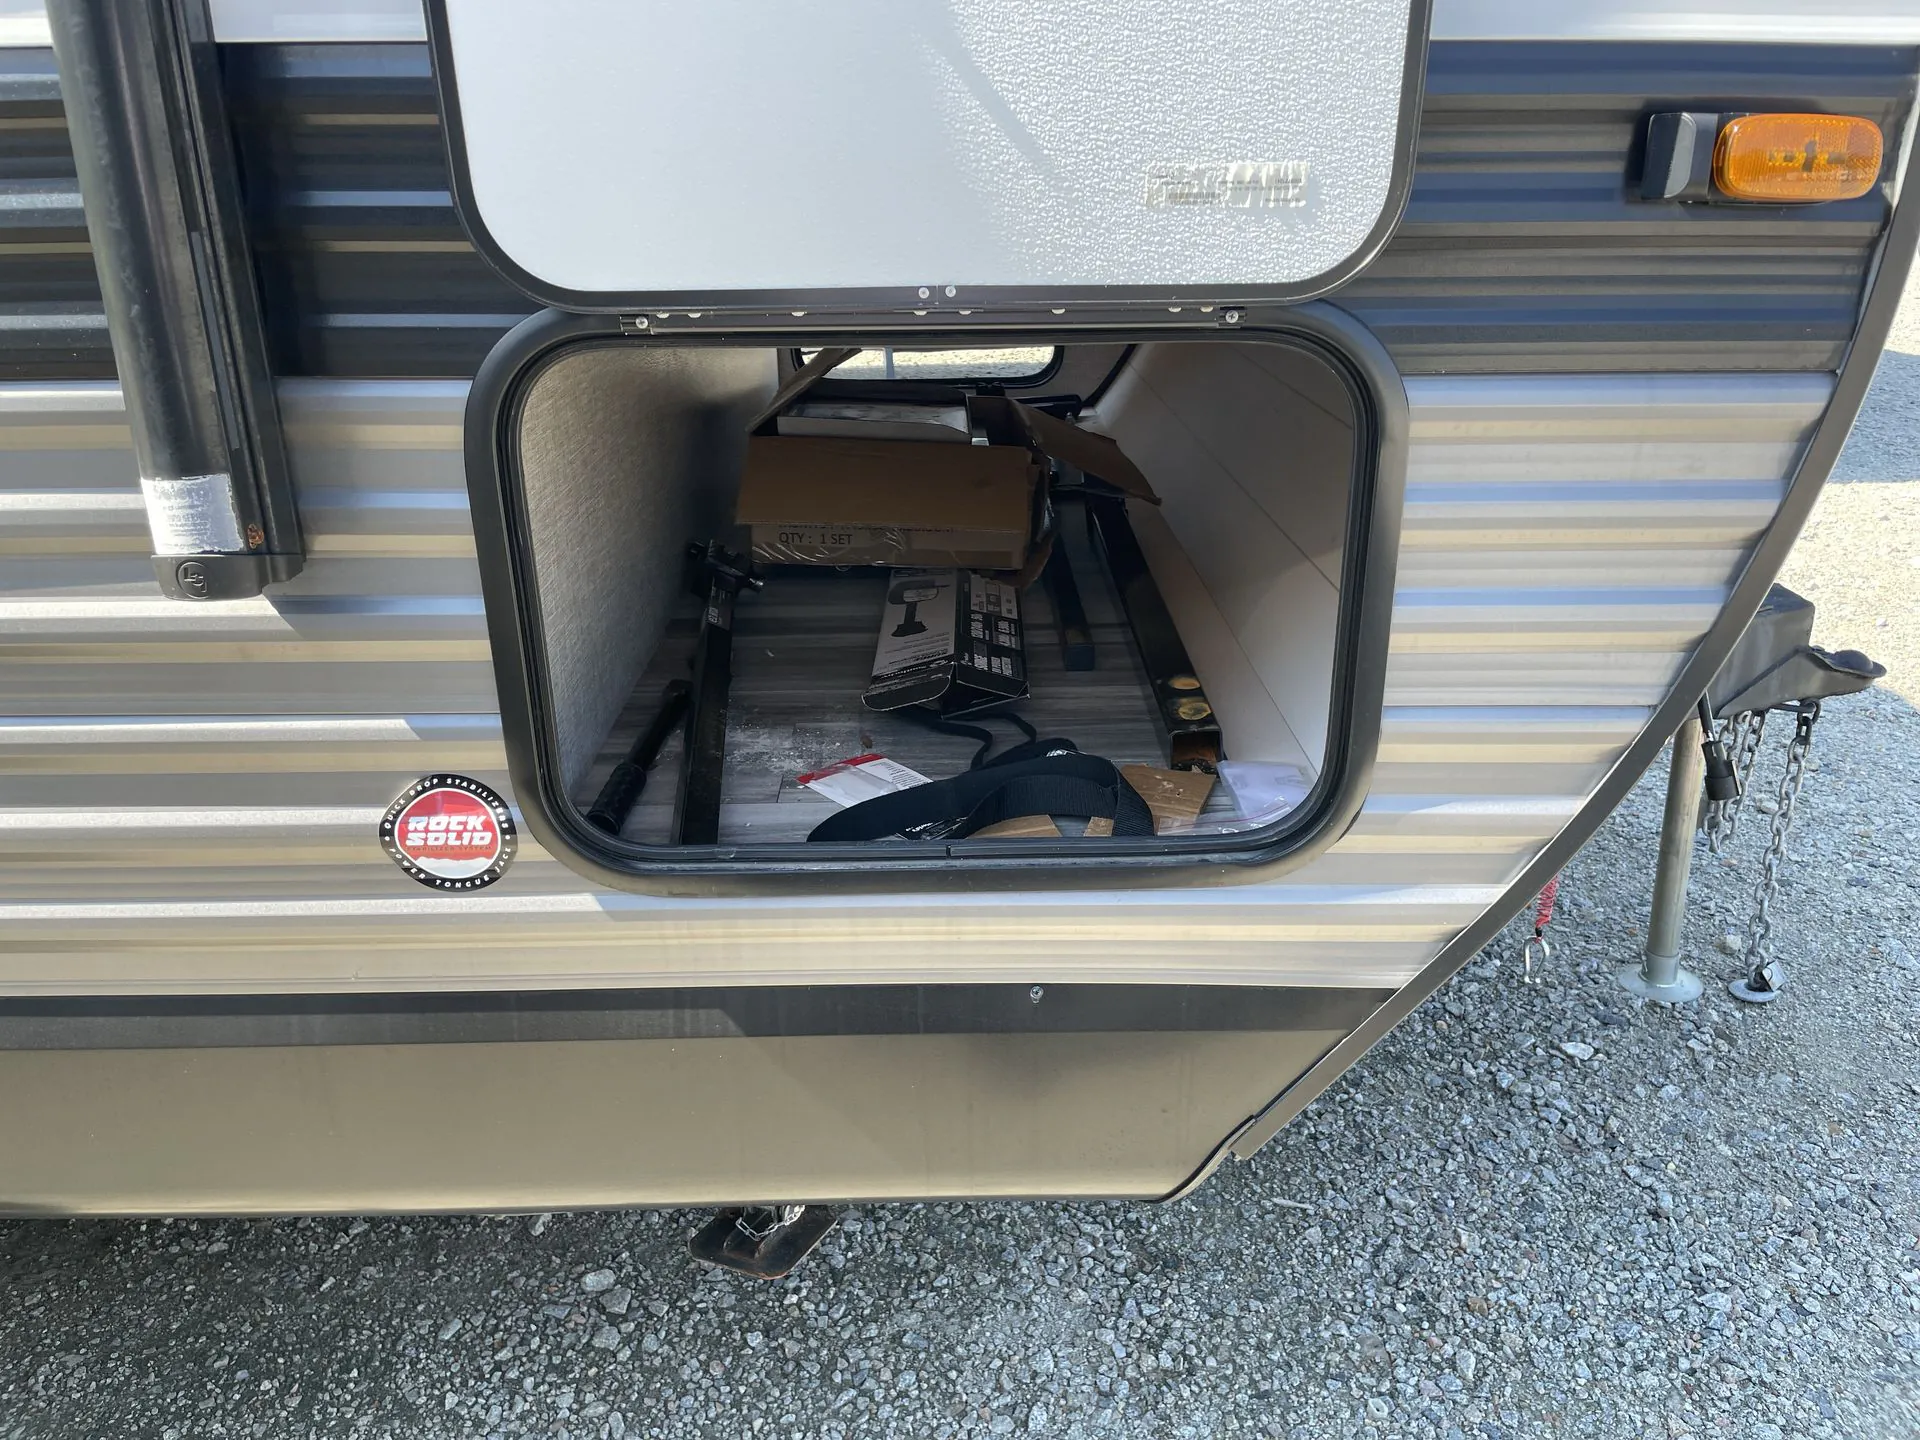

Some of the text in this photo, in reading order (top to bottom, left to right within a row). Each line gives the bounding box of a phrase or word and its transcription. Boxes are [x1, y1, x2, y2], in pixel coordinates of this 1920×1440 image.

[820, 534, 826, 544] 1
[831, 534, 853, 545] SET
[384, 798, 406, 829] QUICK
[409, 778, 438, 796] DROP
[407, 815, 487, 831] ROCK
[405, 832, 492, 846] SOLID
[435, 874, 490, 888] TONGUE
[495, 847, 511, 873] JACK
